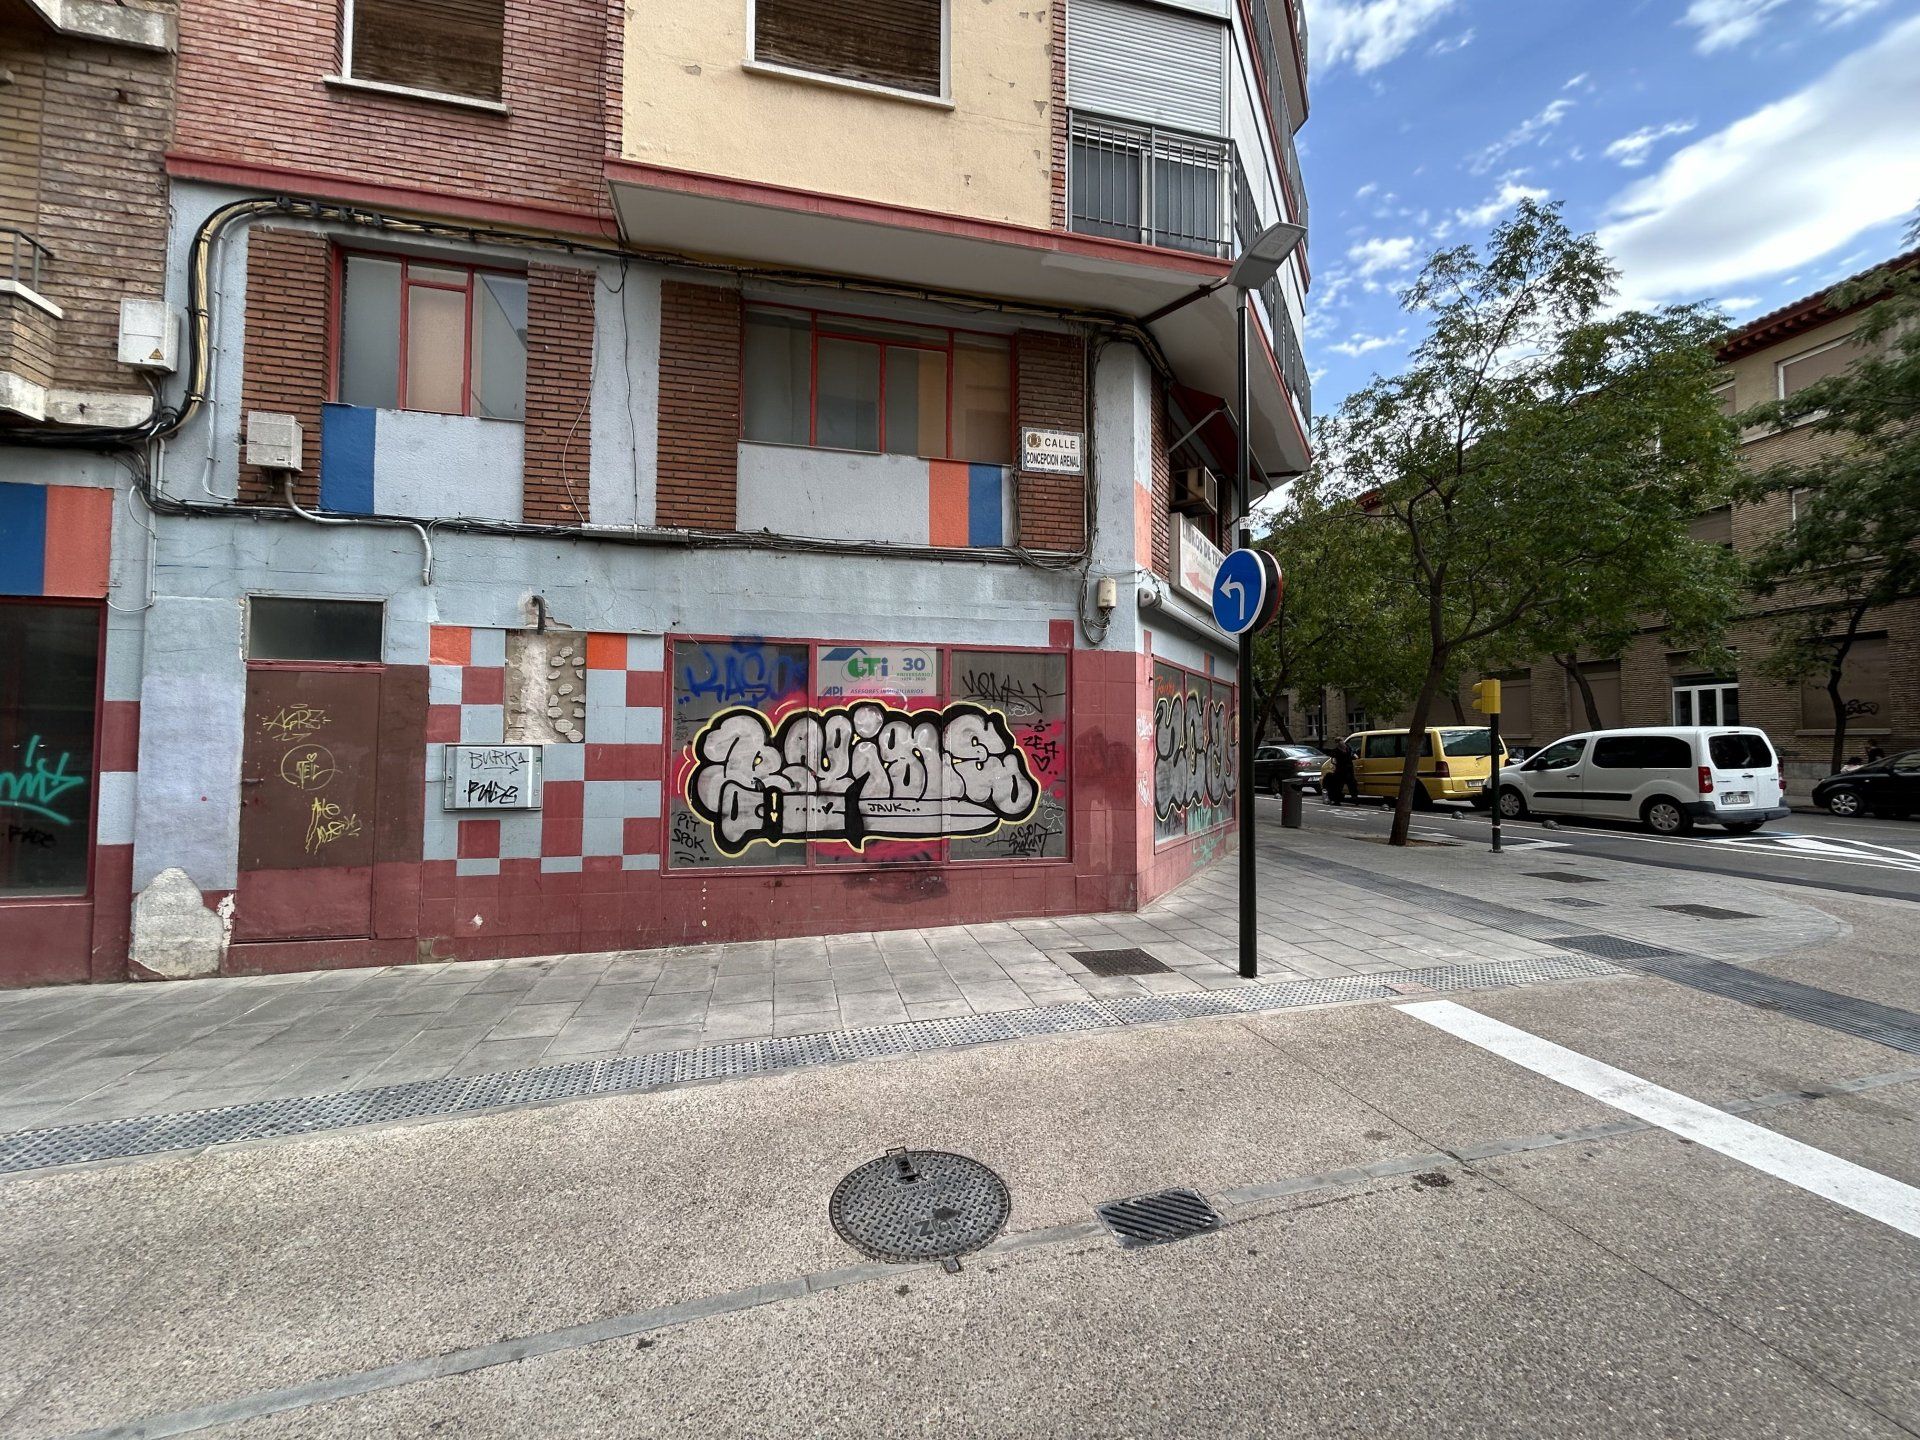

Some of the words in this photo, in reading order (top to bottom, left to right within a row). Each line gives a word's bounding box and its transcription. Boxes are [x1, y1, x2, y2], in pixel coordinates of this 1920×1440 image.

[1044, 437, 1076, 450] CALLE
[1026, 452, 1059, 466] CONCEPCION
[1060, 455, 1080, 468] ARENAL
[1182, 519, 1203, 555] LIBROS
[1203, 540, 1211, 562] DE
[902, 657, 926, 672] 30
